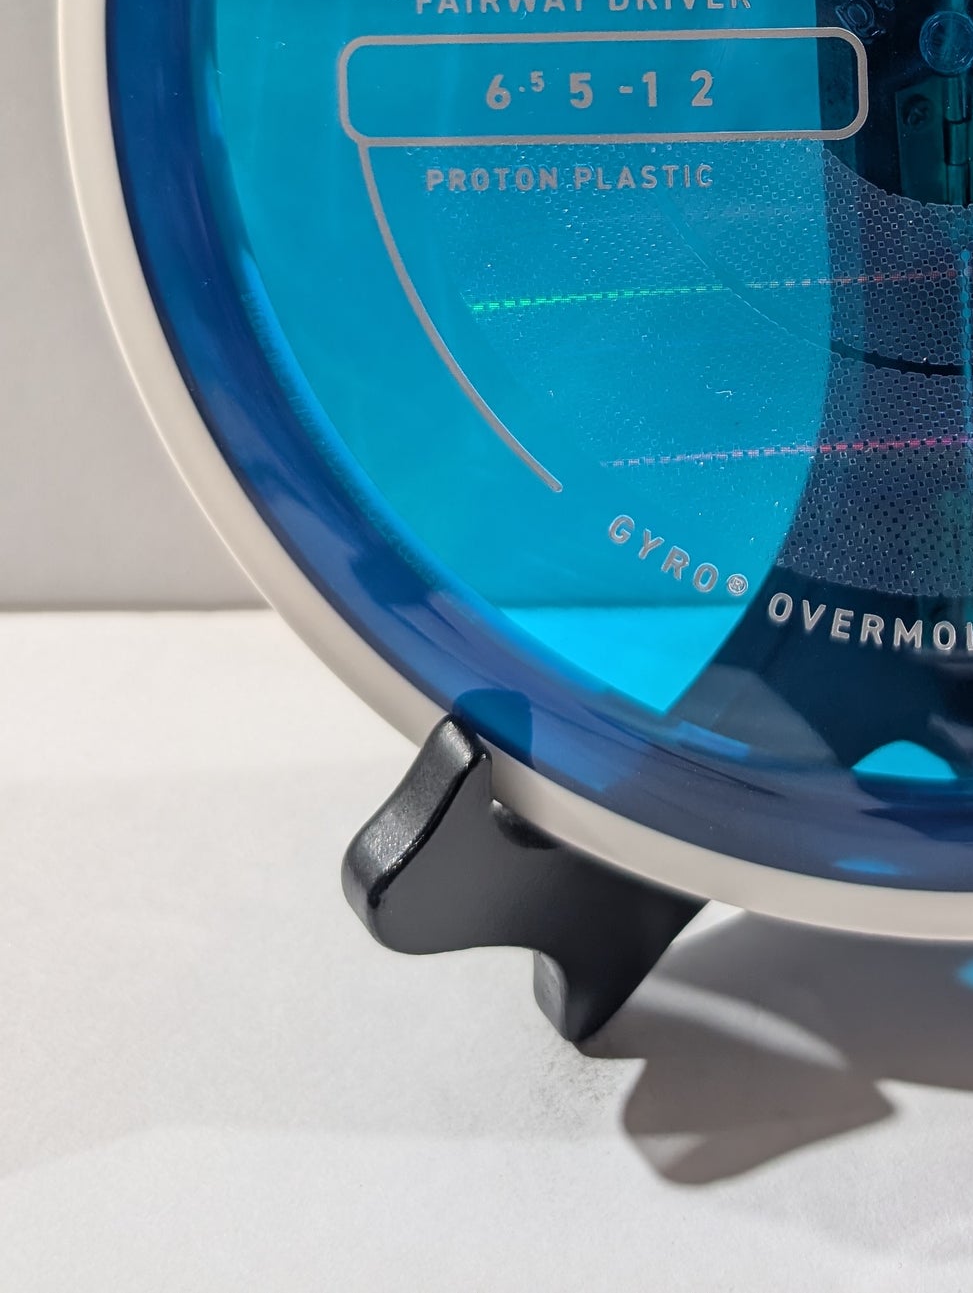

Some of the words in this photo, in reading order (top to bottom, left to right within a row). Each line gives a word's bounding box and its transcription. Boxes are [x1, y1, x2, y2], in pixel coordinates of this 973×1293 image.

[568, 72, 594, 109] 5
[618, 71, 658, 108] -1
[689, 69, 714, 108] 2
[425, 166, 558, 192] PROTON
[574, 164, 714, 191] PLASTIC
